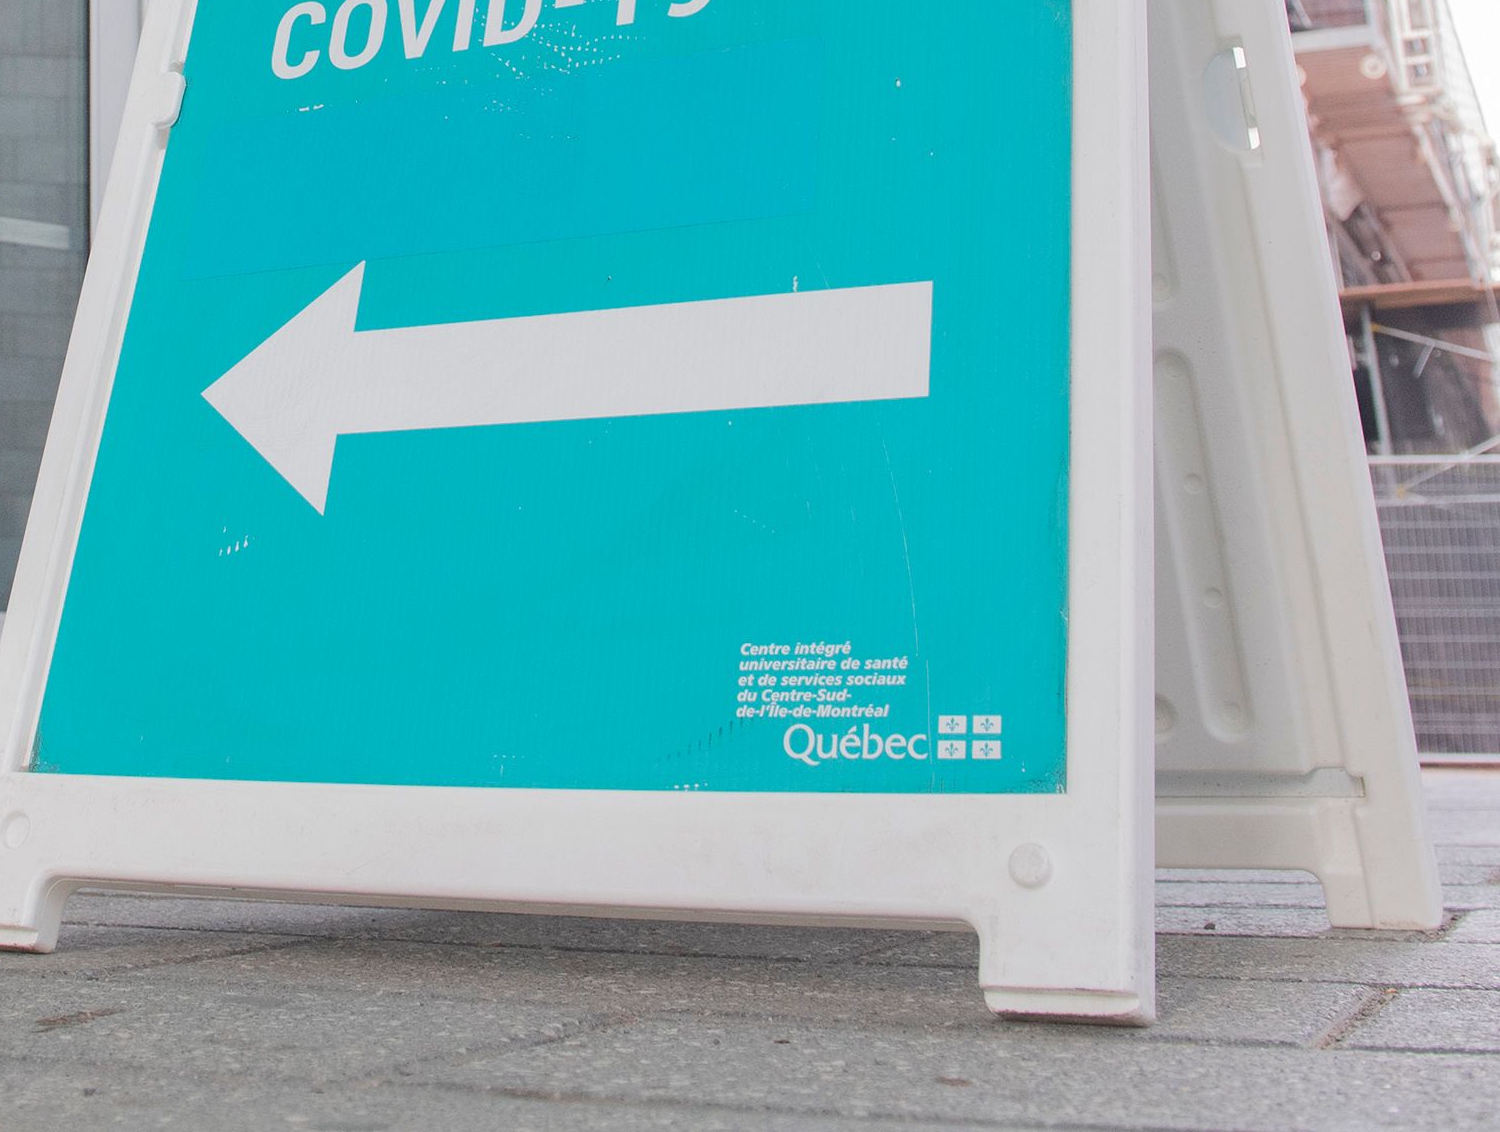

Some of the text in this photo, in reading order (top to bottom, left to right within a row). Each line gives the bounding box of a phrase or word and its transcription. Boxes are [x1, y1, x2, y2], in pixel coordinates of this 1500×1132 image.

[739, 640, 852, 658] Centre intégré
[738, 655, 909, 671] universitaire de santé
[737, 672, 907, 687] et de services sociaux
[736, 688, 853, 703] du Centre-Sud-
[782, 723, 930, 767] Québec
